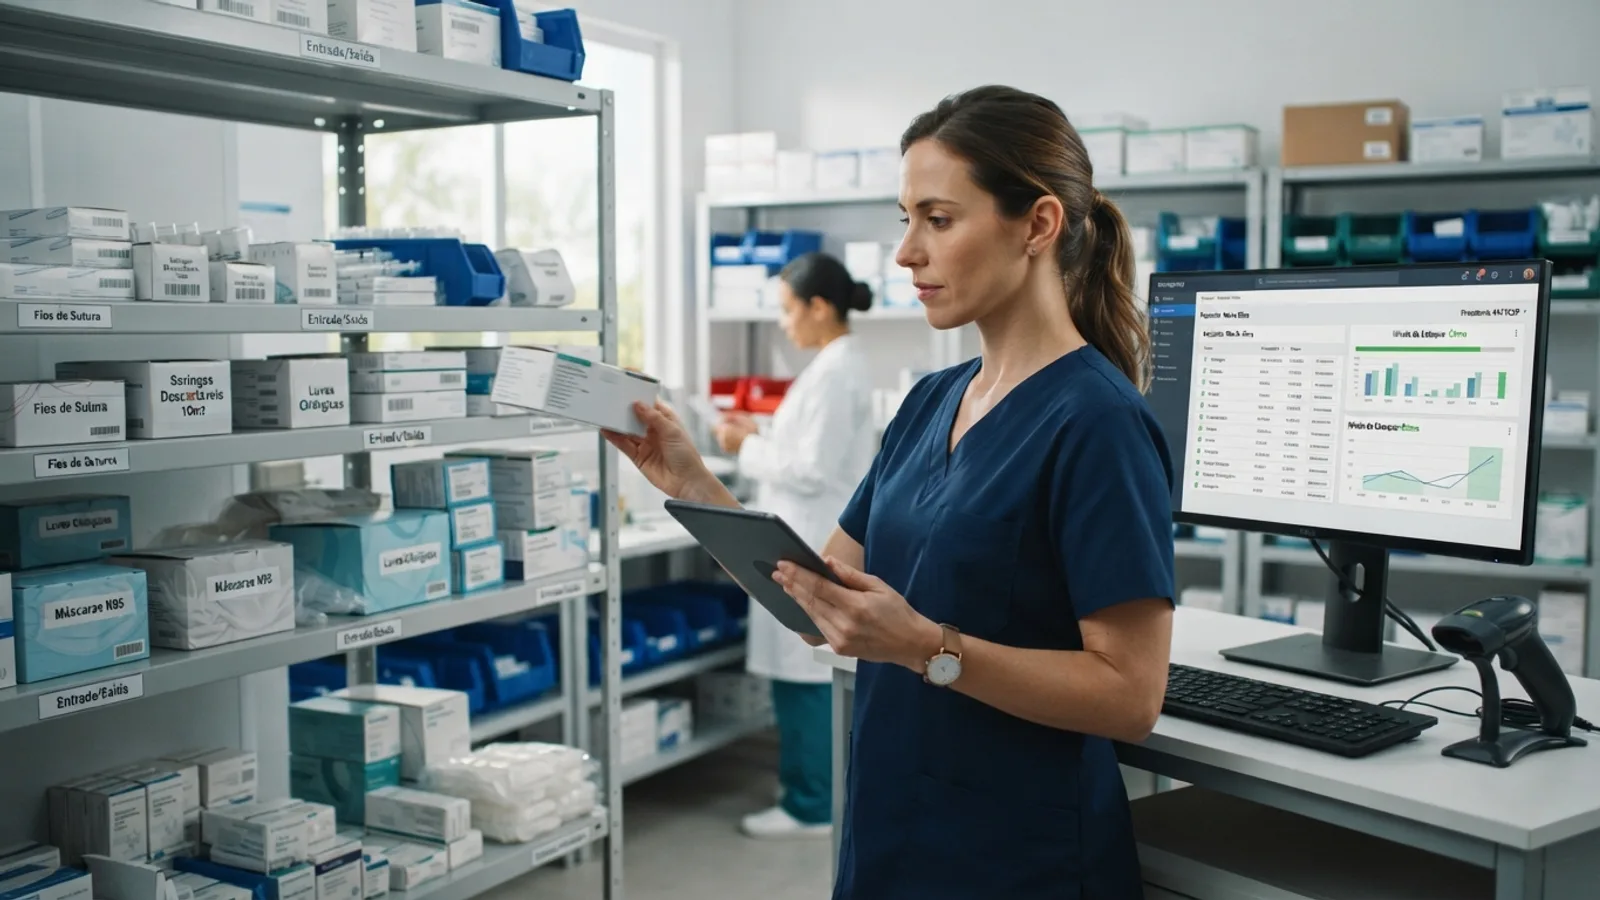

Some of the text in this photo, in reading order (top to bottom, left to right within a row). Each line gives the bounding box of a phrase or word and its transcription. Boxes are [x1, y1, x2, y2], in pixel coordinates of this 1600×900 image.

[34, 309, 101, 321] Fios de Sutura
[59, 401, 72, 413] de
[105, 598, 125, 611] N95
